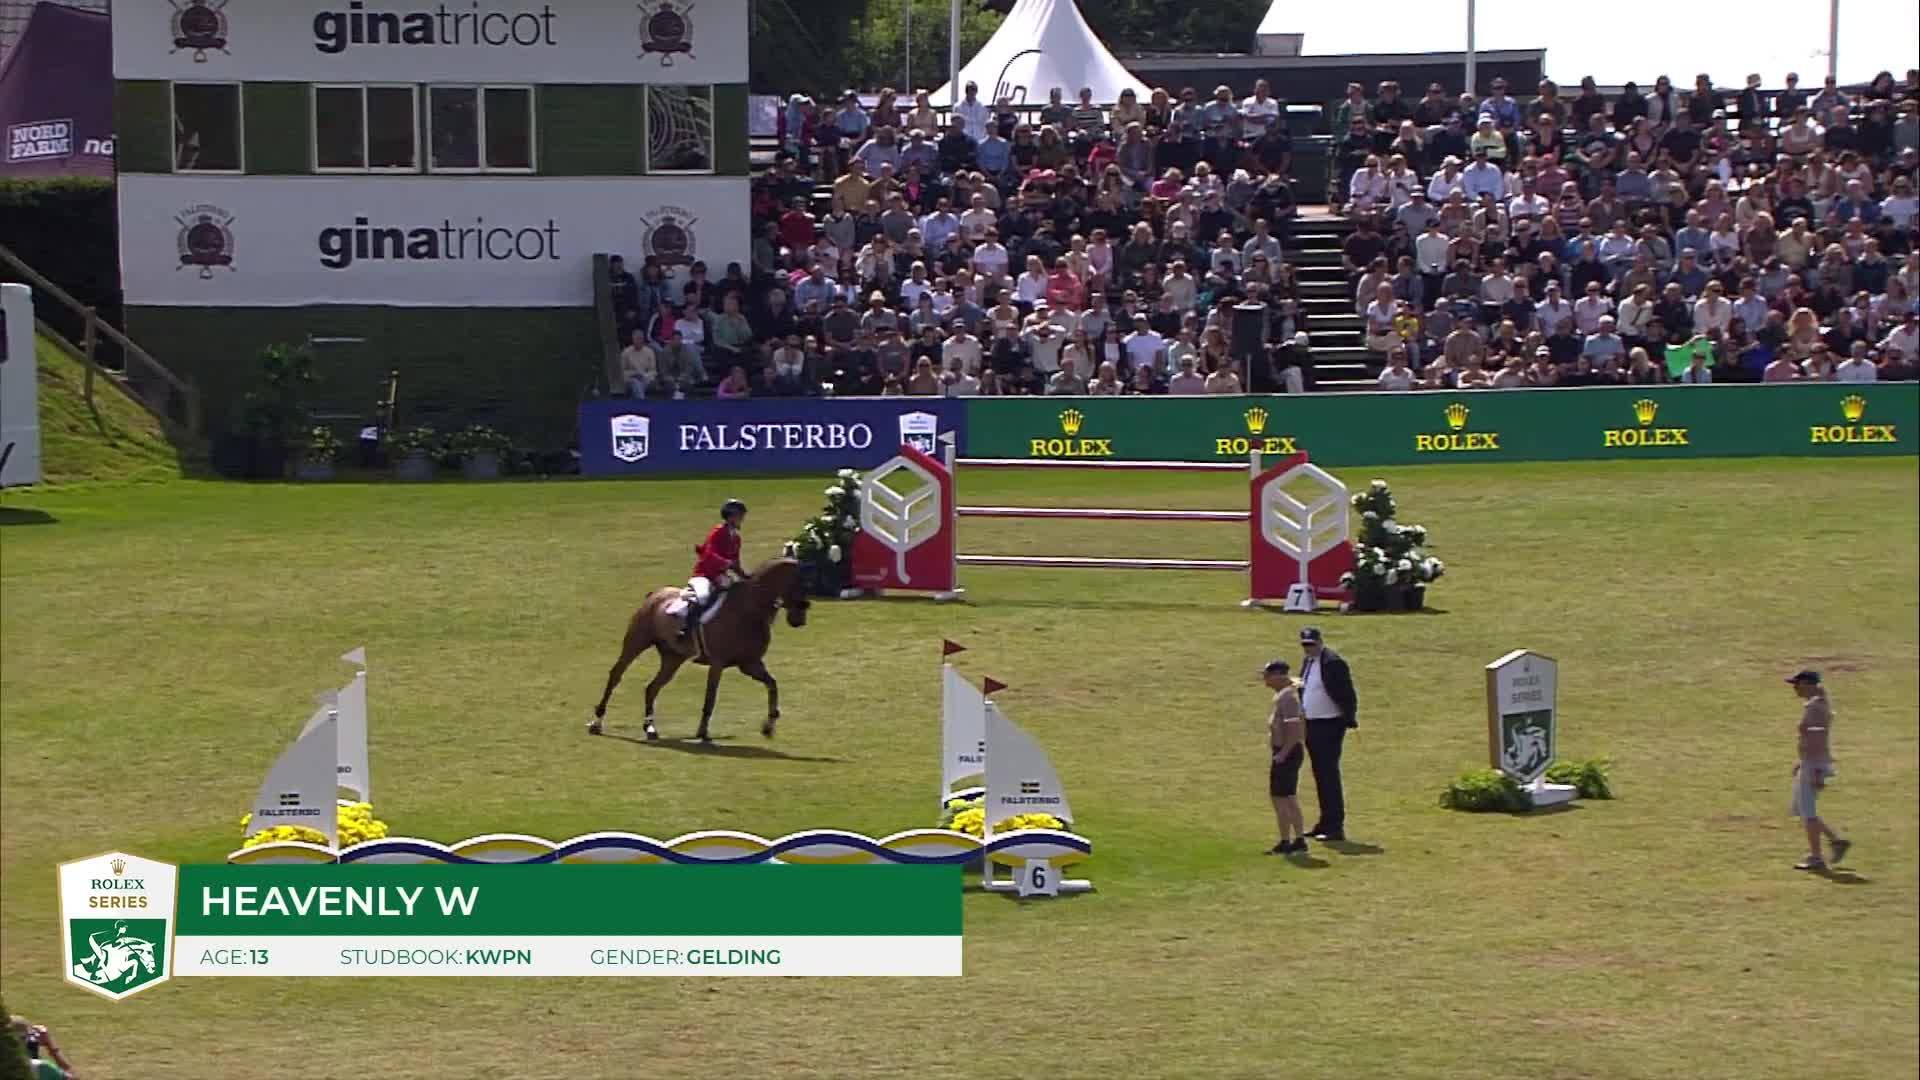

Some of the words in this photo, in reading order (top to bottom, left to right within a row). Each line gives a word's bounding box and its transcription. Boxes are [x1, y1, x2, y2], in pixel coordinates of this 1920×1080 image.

[13, 123, 68, 143] NORD
[12, 139, 69, 158] FARM
[680, 423, 873, 450] FALSTERBO
[1416, 433, 1499, 450] ROLEX
[1604, 428, 1688, 446] ROLEX
[1809, 425, 1897, 442] ROLEX
[1031, 439, 1114, 456] ROLEX
[1216, 437, 1297, 454] ROEX
[1294, 589, 1304, 606] 7
[1032, 866, 1045, 889] 6
